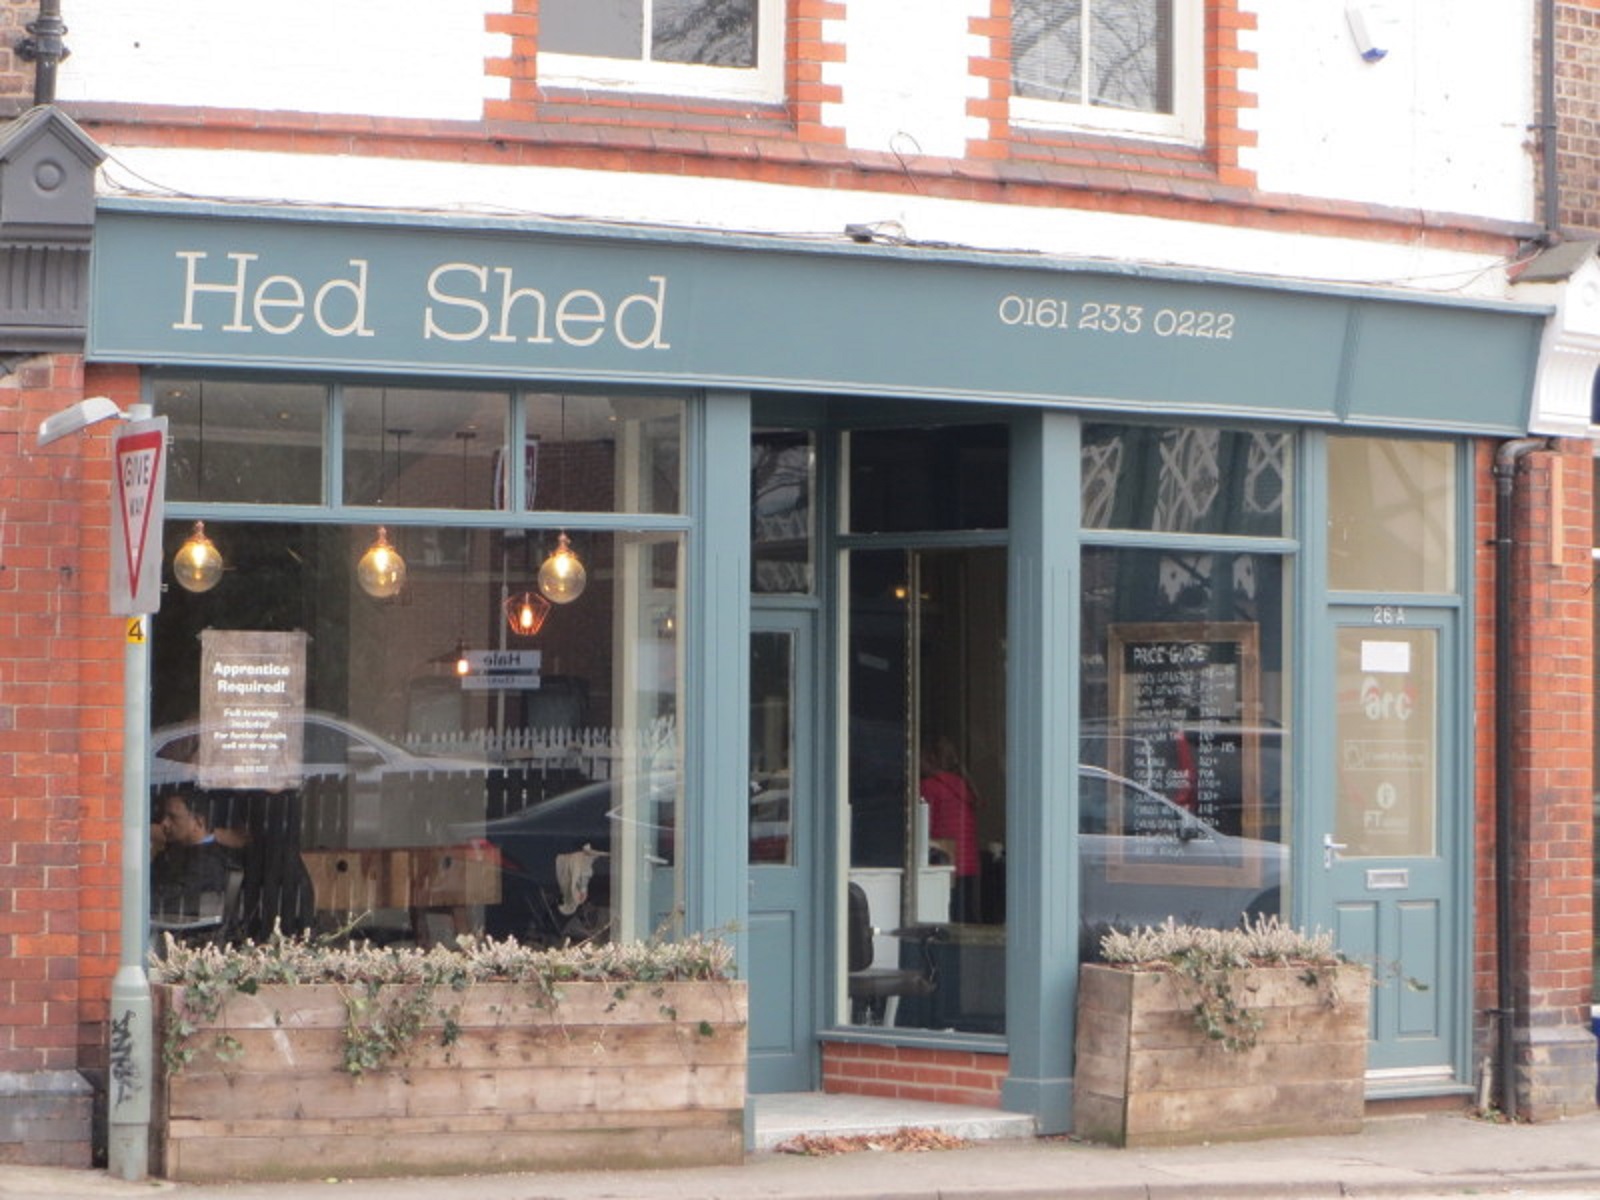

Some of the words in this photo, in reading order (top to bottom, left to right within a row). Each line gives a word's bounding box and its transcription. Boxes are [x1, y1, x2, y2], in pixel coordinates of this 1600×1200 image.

[172, 251, 375, 337] Hed
[423, 262, 671, 350] Shed
[999, 295, 1069, 329] 0161
[1077, 303, 1144, 333] 233
[1153, 309, 1235, 339] 0222
[124, 456, 150, 487] GIVE
[128, 621, 143, 641] 4
[213, 662, 291, 677] Apprentice
[217, 680, 286, 694] Required!
